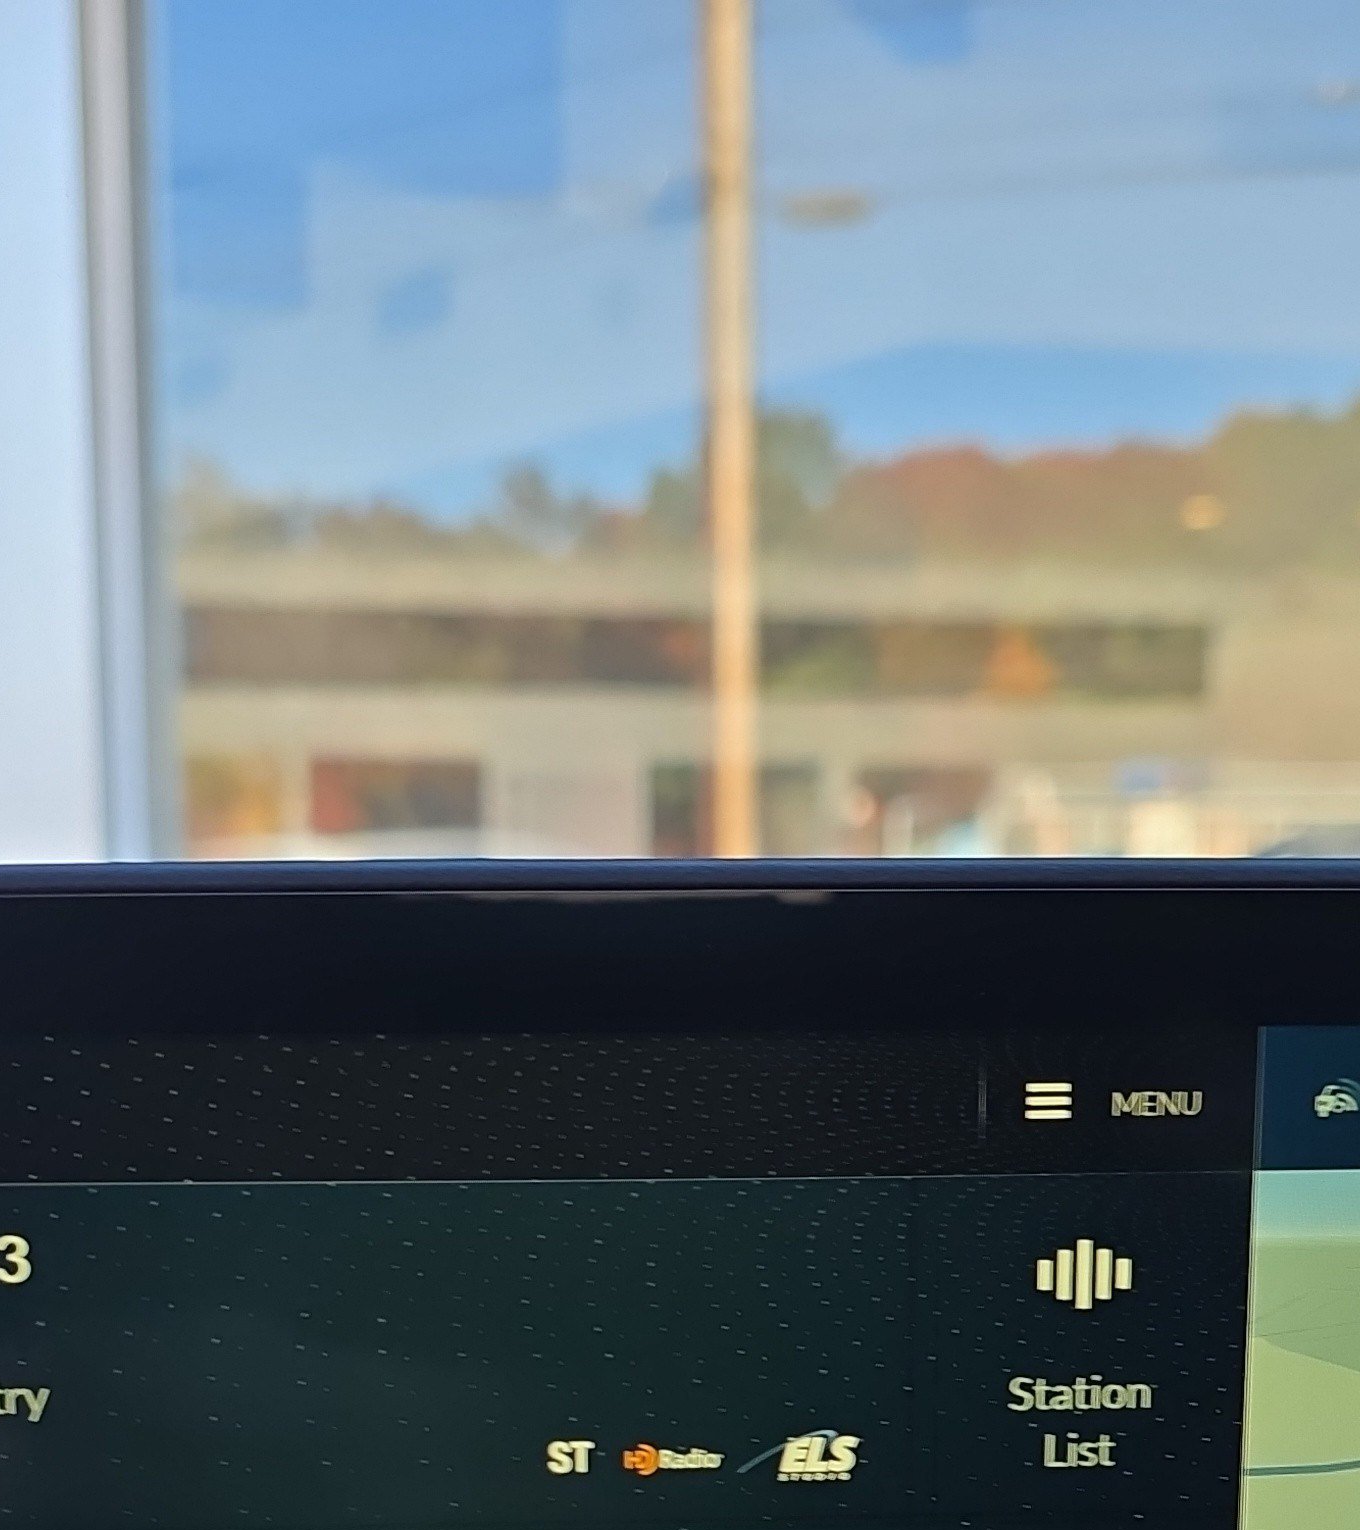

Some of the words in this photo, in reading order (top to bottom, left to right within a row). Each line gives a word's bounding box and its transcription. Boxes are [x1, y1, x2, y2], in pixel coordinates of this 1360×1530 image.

[1111, 1090, 1203, 1117] MENU
[1007, 1374, 1152, 1412] Station
[546, 1440, 596, 1474] ST
[778, 1435, 860, 1473] ELS
[1043, 1432, 1117, 1468] List
